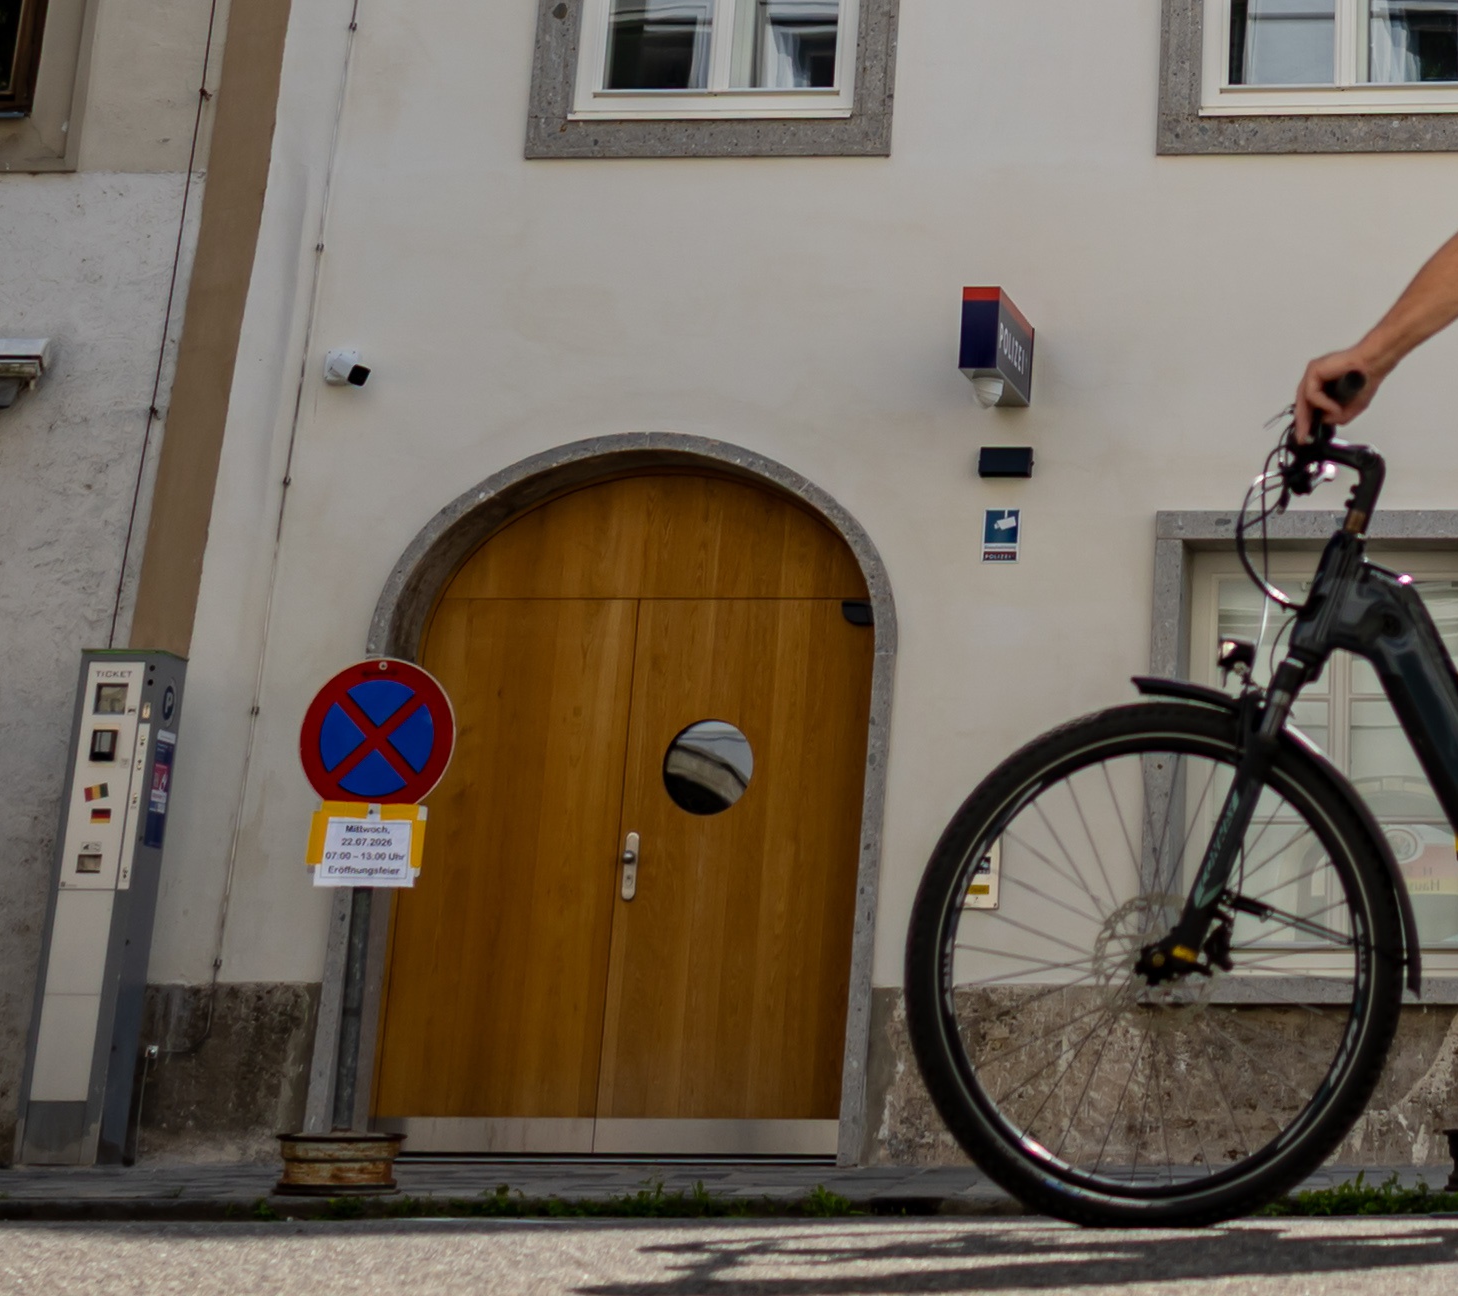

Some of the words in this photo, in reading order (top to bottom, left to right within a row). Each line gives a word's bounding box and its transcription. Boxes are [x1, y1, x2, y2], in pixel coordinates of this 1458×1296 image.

[998, 321, 1025, 375] POLIZEI
[95, 670, 133, 678] TICKET
[164, 692, 174, 712] P
[345, 825, 390, 834] Mittwoch,
[341, 838, 393, 847] 22.07.2026
[388, 853, 406, 861] Uhr
[327, 865, 401, 876] Eröffnungsfeier
